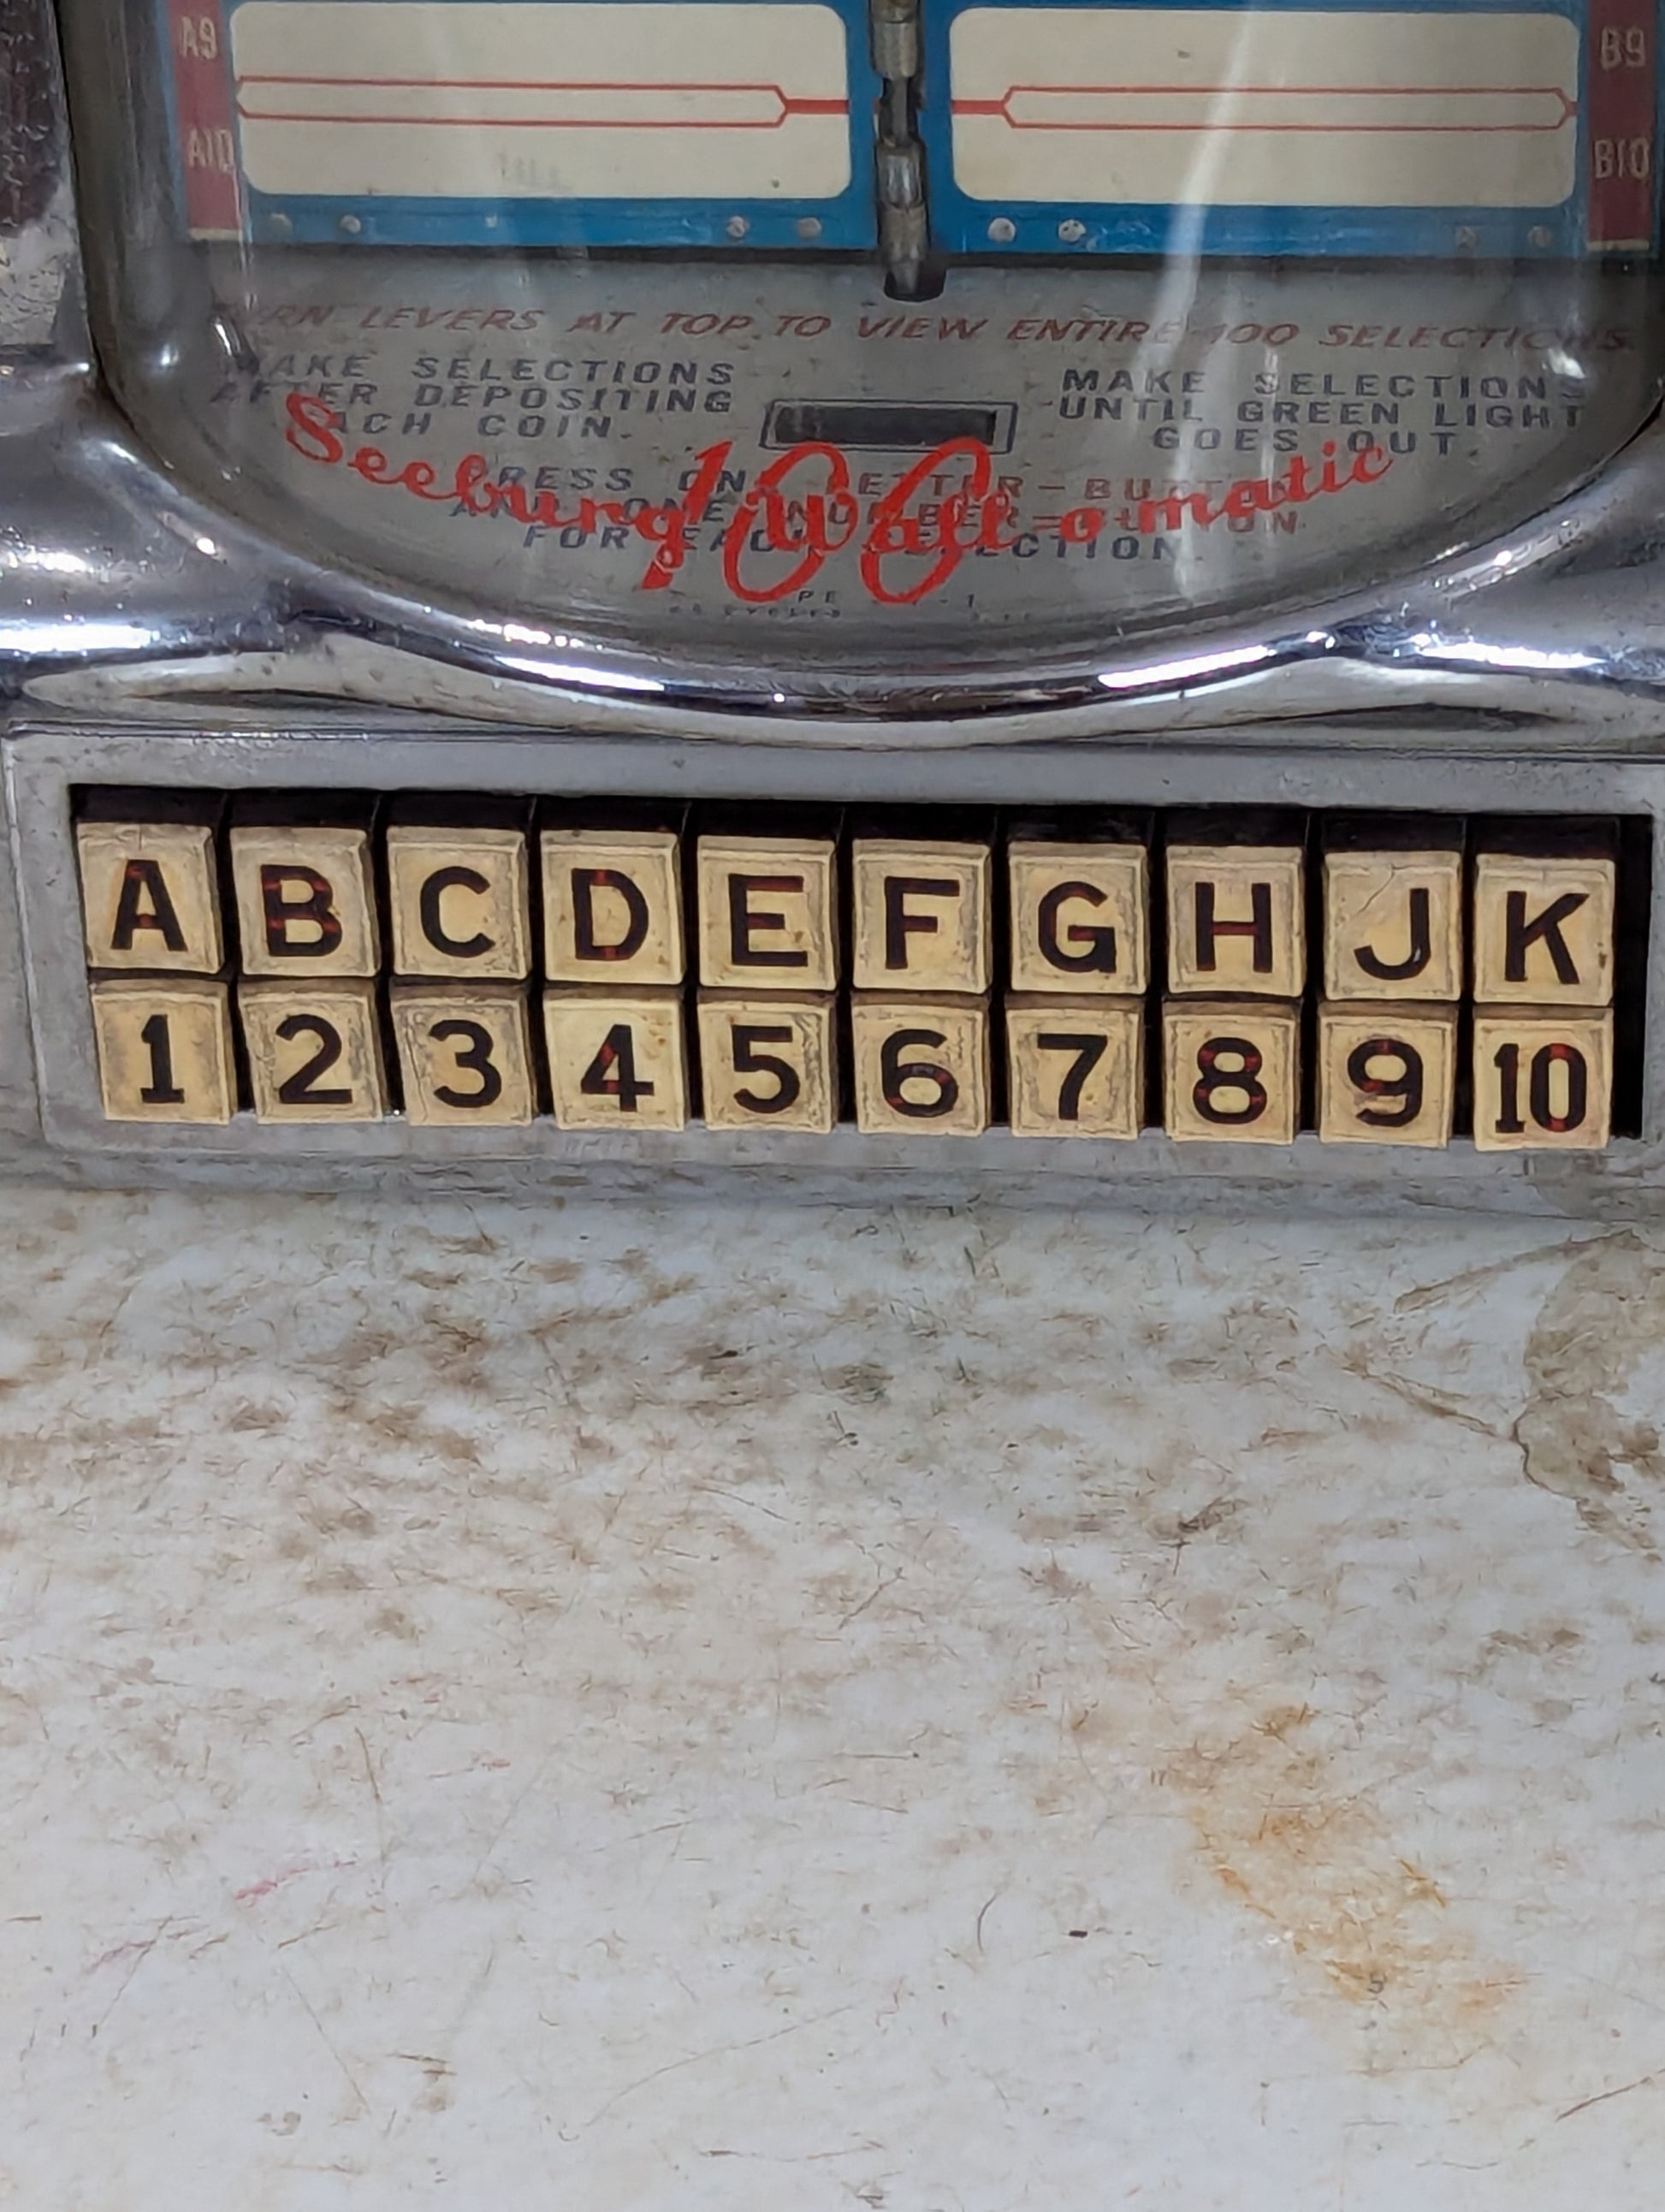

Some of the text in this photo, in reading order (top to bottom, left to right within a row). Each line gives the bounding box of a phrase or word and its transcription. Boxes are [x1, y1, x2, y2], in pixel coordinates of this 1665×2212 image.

[181, 16, 217, 59] A9
[1601, 27, 1646, 69] B9
[1595, 138, 1650, 178] B10
[358, 305, 545, 332] LEVERS
[566, 311, 637, 334] AT
[660, 312, 754, 335] TOP
[774, 316, 831, 336] TO
[856, 317, 987, 340] VIEW
[226, 353, 735, 386] AKE SELECTIONS
[1063, 368, 1206, 394] MAKE
[414, 385, 733, 414] DEPOSITING
[1058, 396, 1585, 429] UNTIL GREEN LIGHT
[477, 414, 632, 440] COIN.
[1153, 427, 1300, 452] GOES
[286, 391, 688, 591] Seeburg
[468, 467, 633, 492] RESS
[523, 525, 630, 549] FOR
[110, 859, 1590, 985] A B C D E F G H J K
[140, 1014, 1587, 1134] 1 2 3 4 5 6 7 8 9 10
